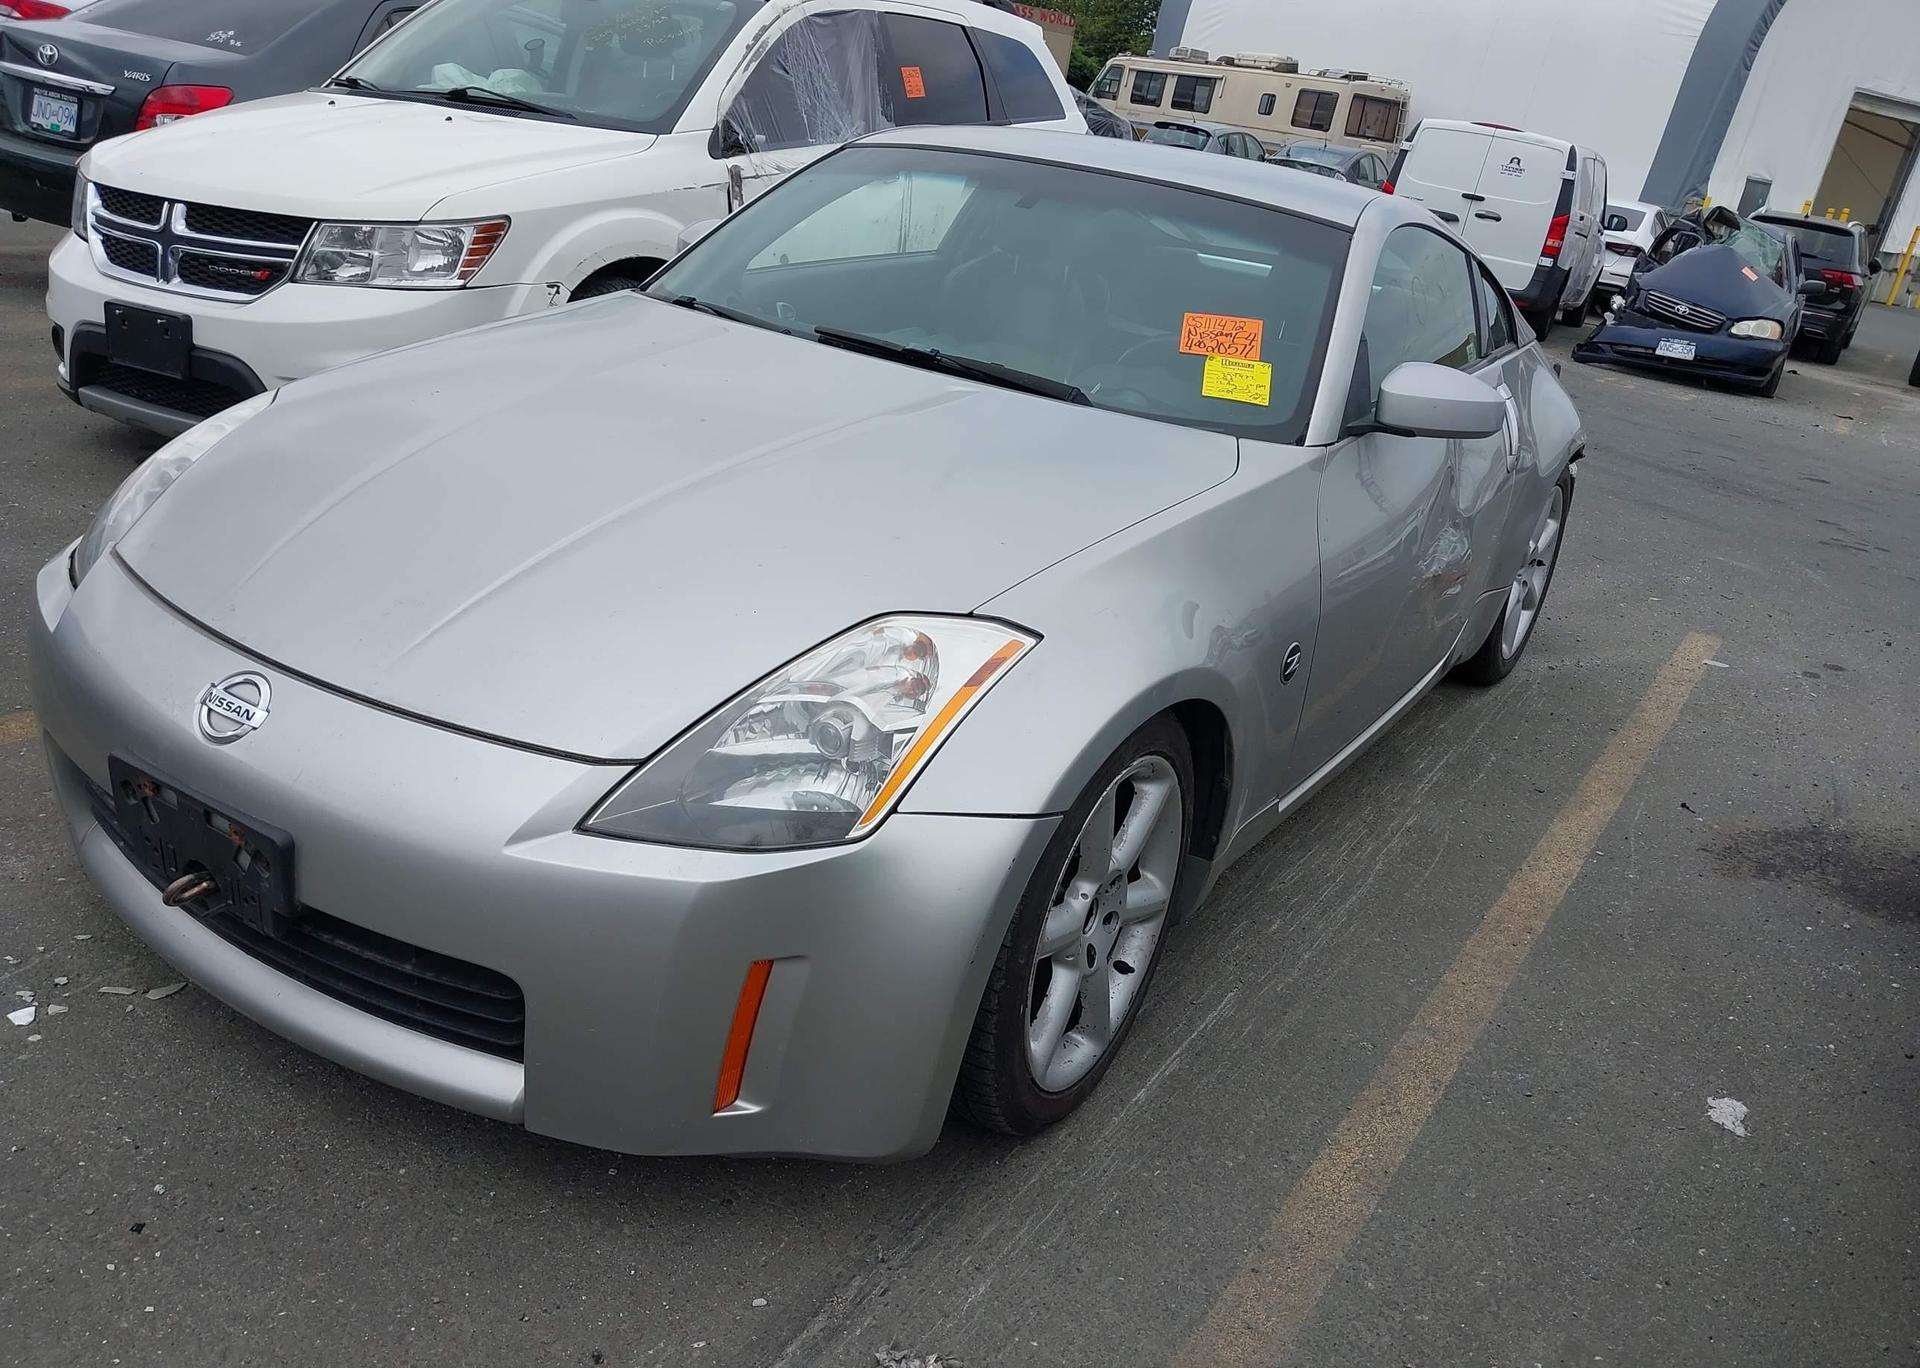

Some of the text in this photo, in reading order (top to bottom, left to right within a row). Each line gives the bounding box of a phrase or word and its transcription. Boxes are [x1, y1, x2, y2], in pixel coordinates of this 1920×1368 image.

[1040, 11, 1075, 27] WORLD
[123, 70, 152, 82] YARIS
[206, 691, 256, 722] NISSAN
